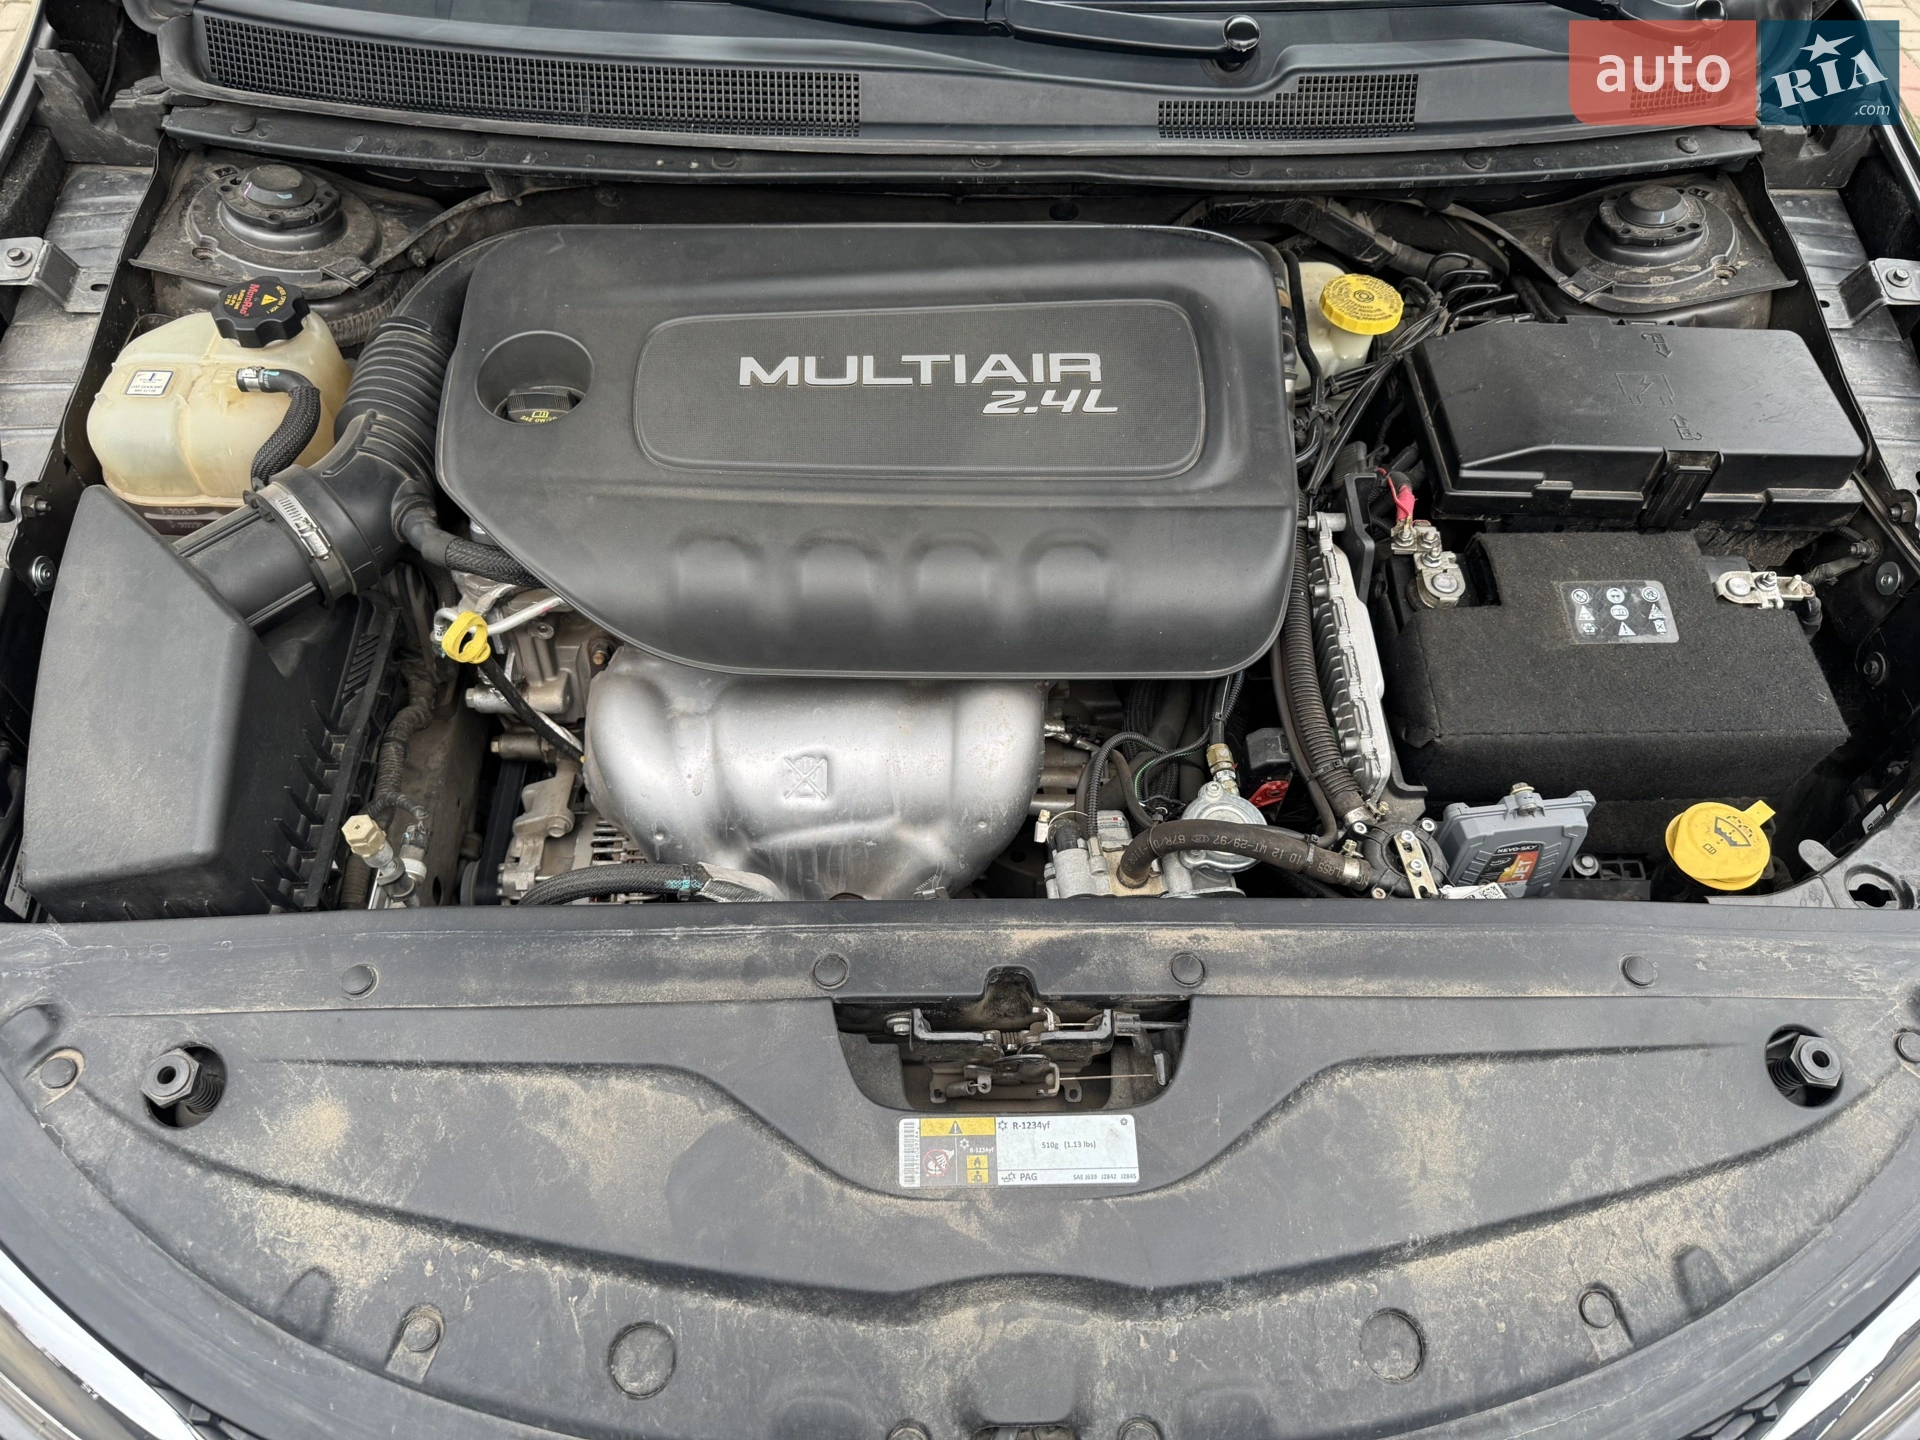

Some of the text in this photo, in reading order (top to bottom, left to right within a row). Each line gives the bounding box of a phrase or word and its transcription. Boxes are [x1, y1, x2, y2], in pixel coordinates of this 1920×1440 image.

[739, 353, 1102, 386] MULTIAIR
[981, 389, 1118, 414] 2.4L
[520, 415, 534, 423] SAE
[1512, 860, 1533, 880] JET
[1012, 1121, 1050, 1131] R-1234yf
[1041, 1140, 1096, 1150] 510g (1.13 lbs)
[1020, 1173, 1038, 1181] PAG
